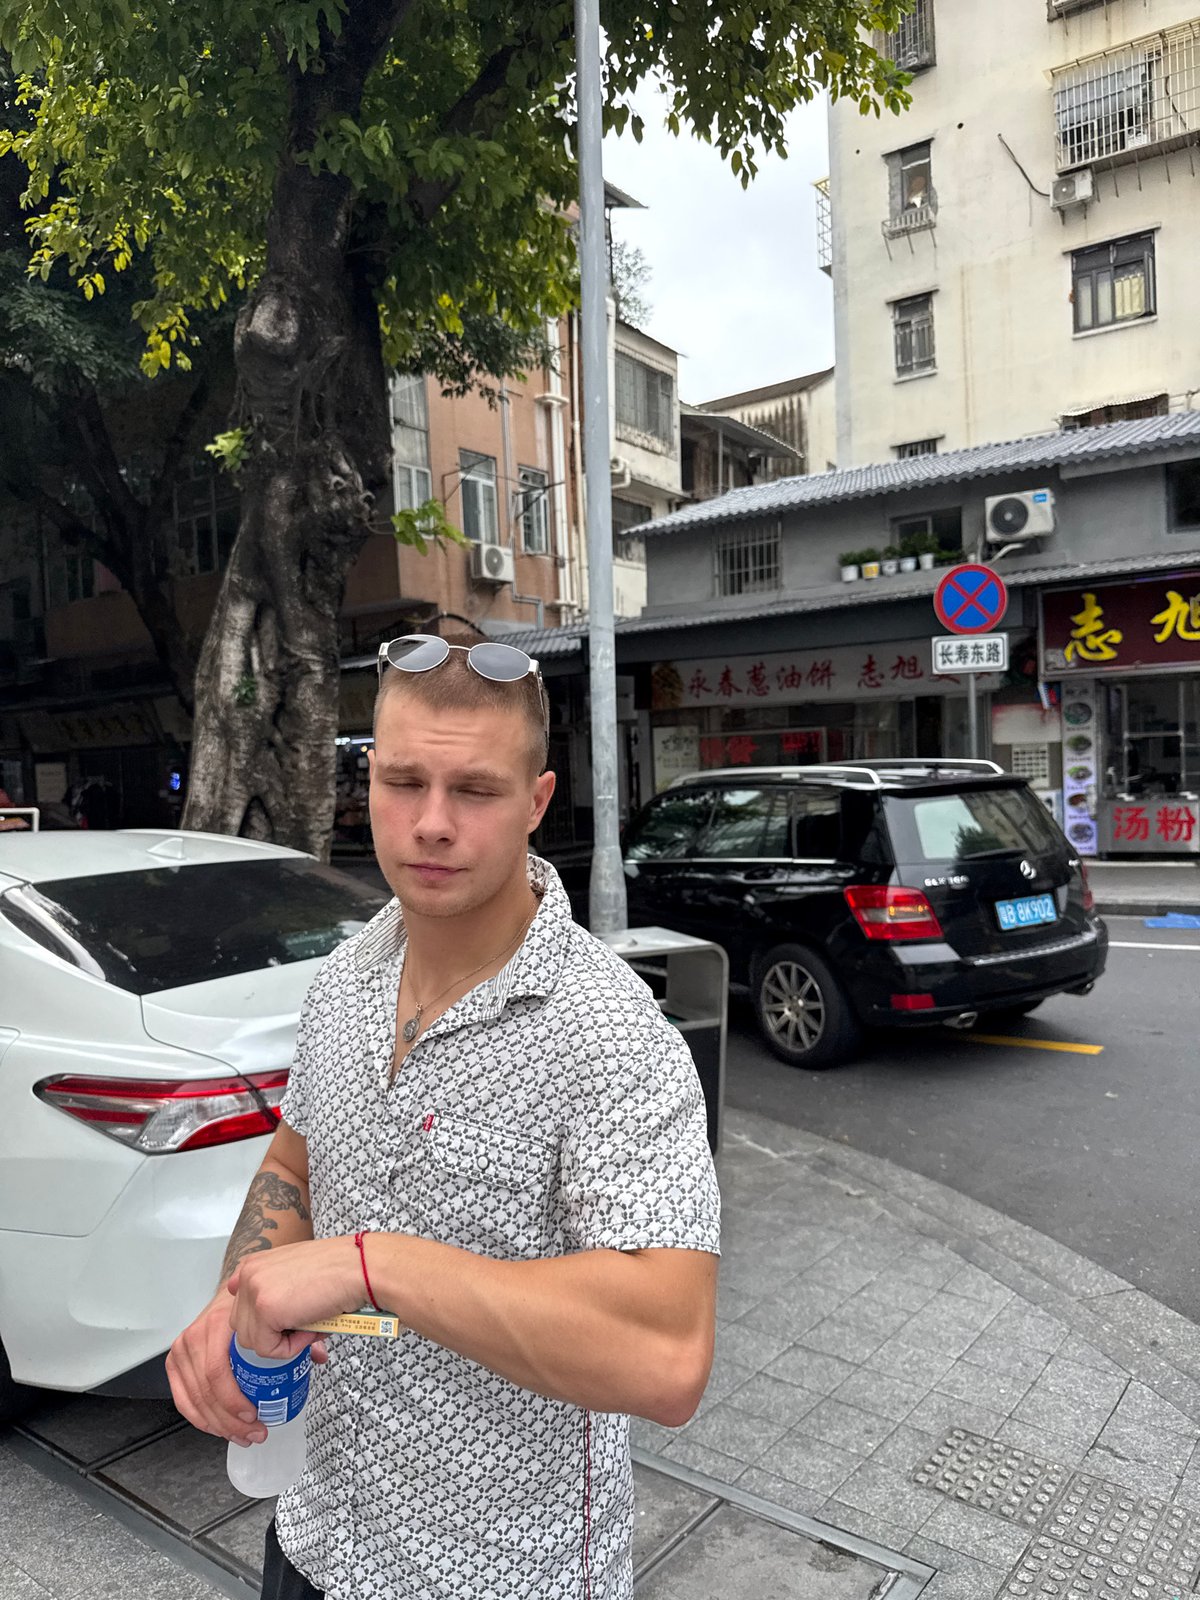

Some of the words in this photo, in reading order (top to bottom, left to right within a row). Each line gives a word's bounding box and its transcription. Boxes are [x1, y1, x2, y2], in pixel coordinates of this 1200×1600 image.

[939, 641, 1001, 666] 长寿东路
[1113, 805, 1196, 843] 汤粉
